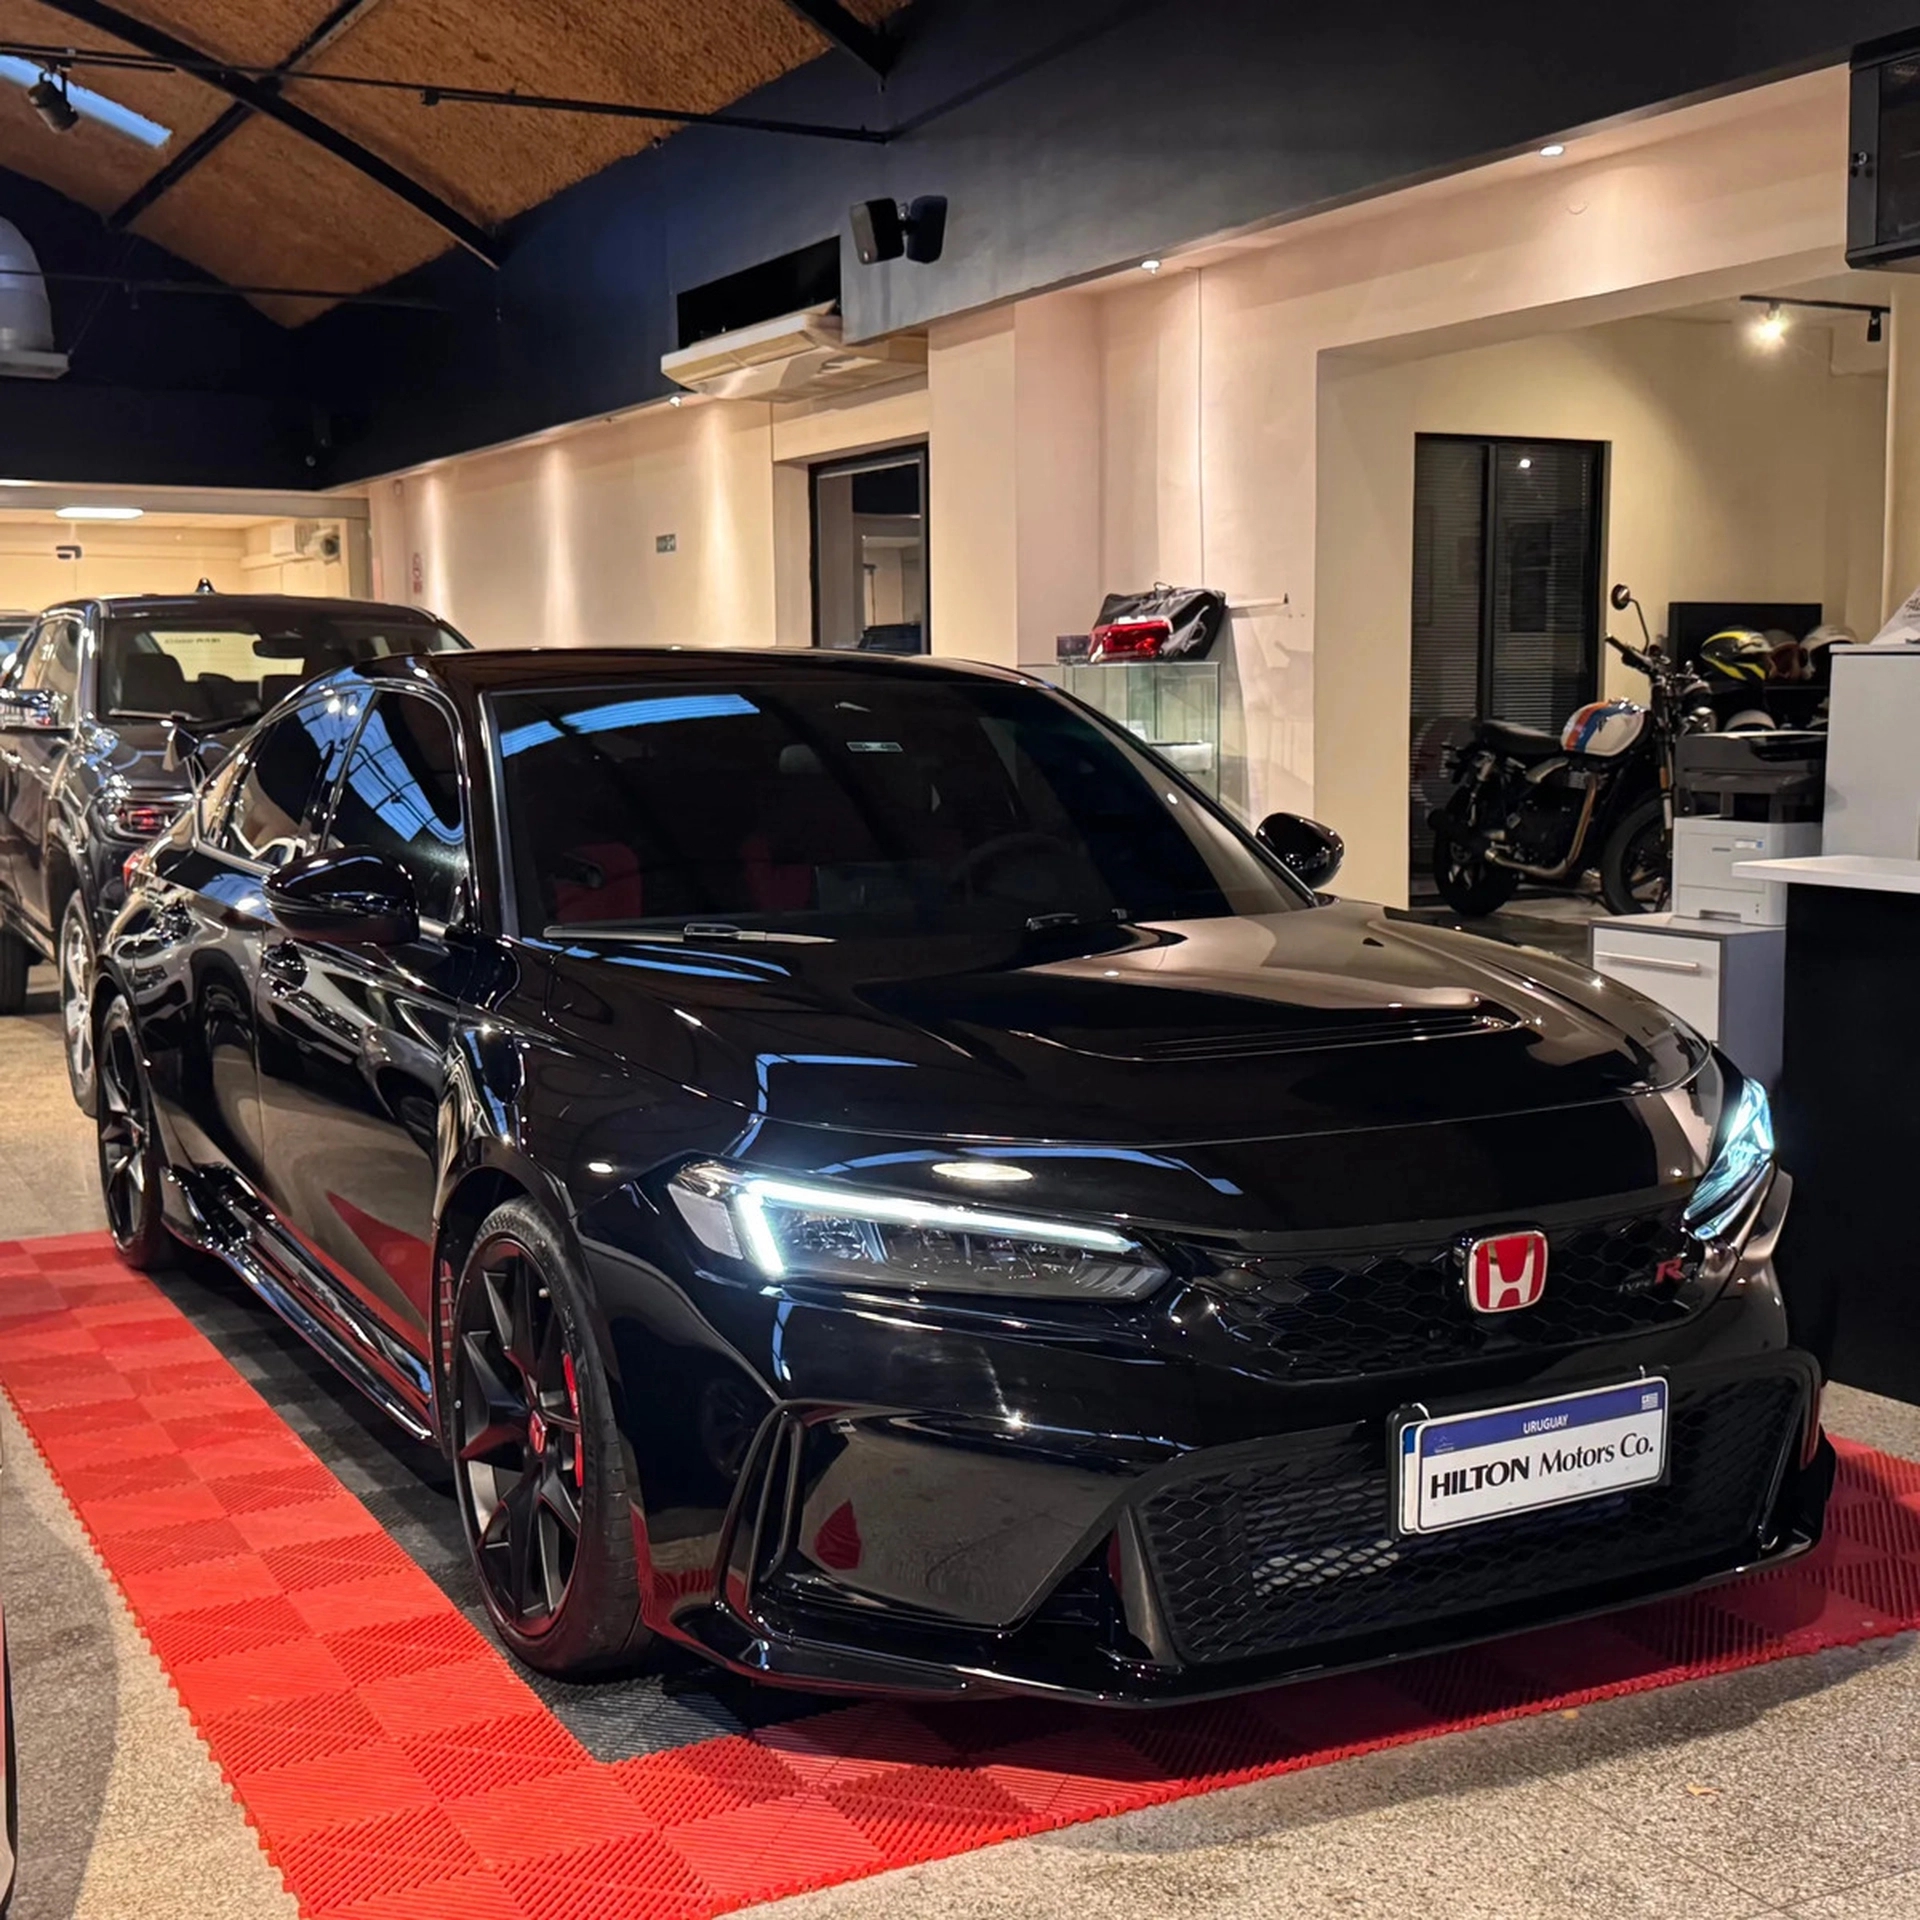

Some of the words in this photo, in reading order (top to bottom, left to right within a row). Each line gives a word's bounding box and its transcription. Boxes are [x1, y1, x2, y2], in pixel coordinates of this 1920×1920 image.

[1655, 1257, 1686, 1284] R
[1522, 1413, 1569, 1435] URUGUAY
[1430, 1455, 1530, 1500] HILTON
[1538, 1444, 1615, 1477] Motors
[1620, 1432, 1654, 1458] Co.
